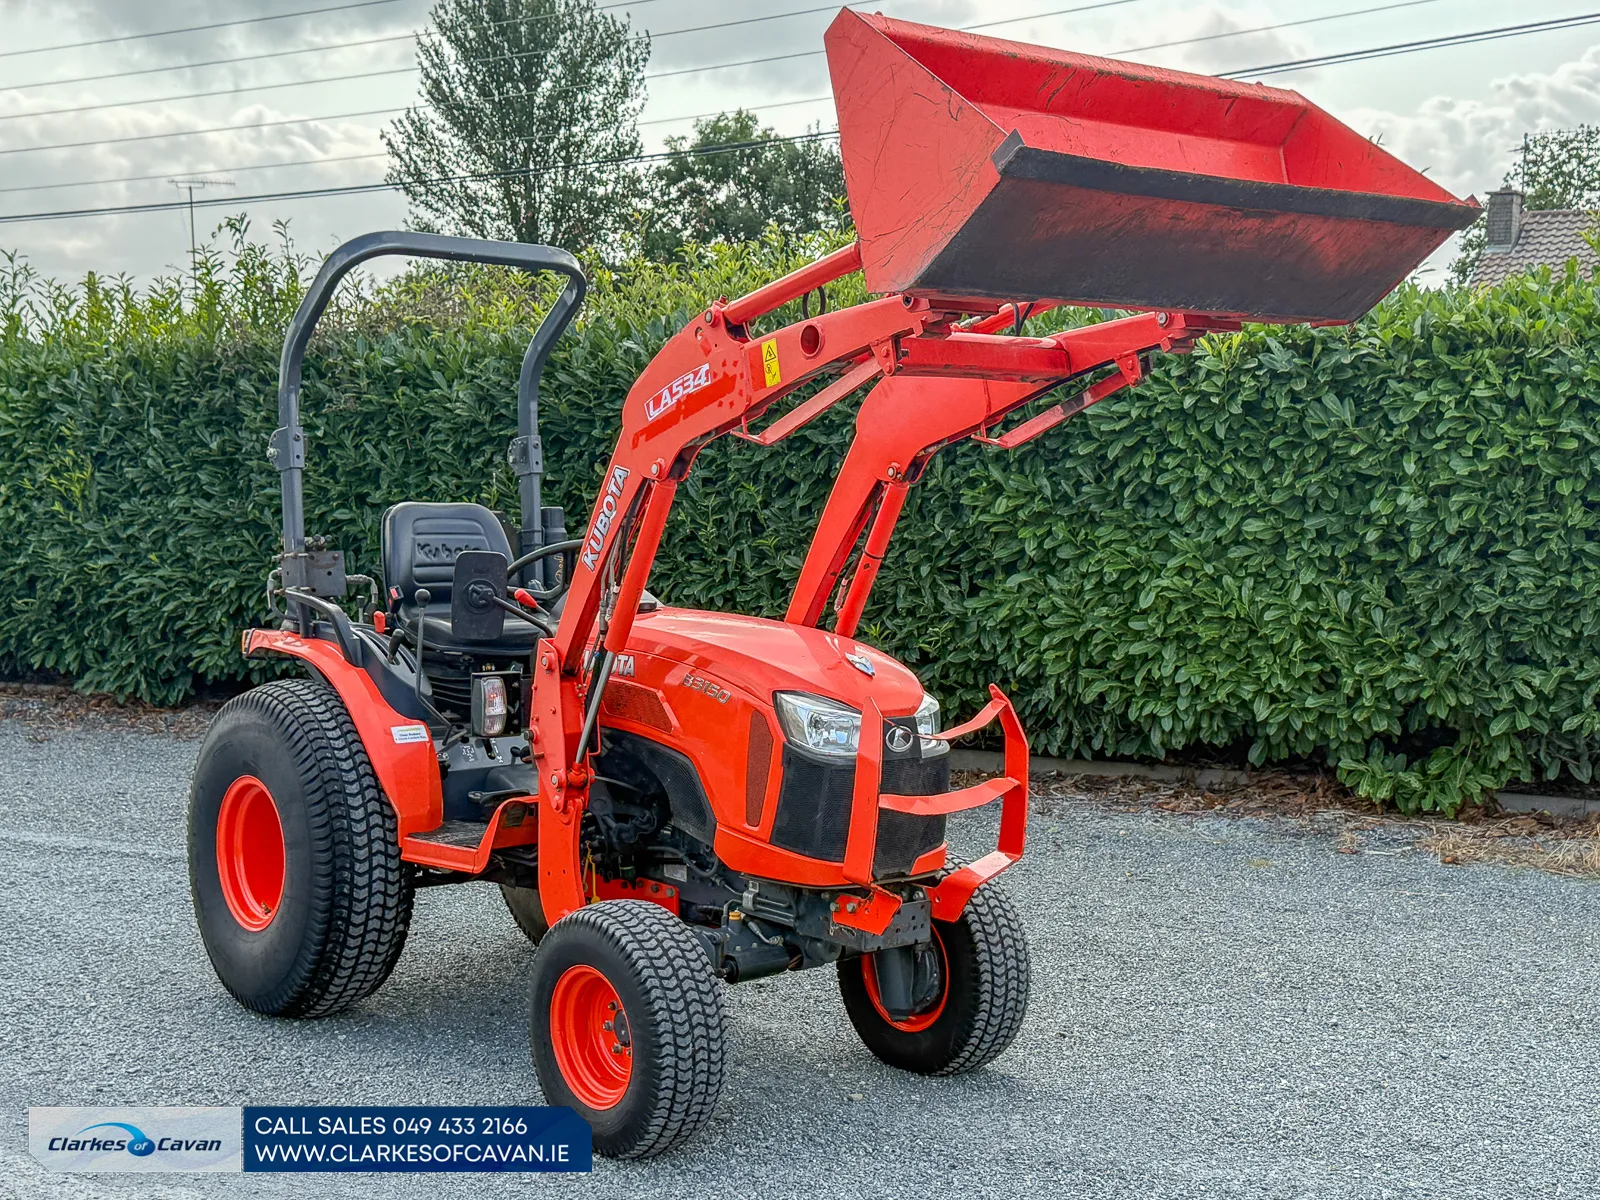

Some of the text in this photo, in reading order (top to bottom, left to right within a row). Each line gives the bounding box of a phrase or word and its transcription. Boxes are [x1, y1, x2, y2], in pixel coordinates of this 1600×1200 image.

[648, 363, 710, 417] LA534
[582, 464, 631, 572] KUBOTA
[682, 673, 731, 704] B3150
